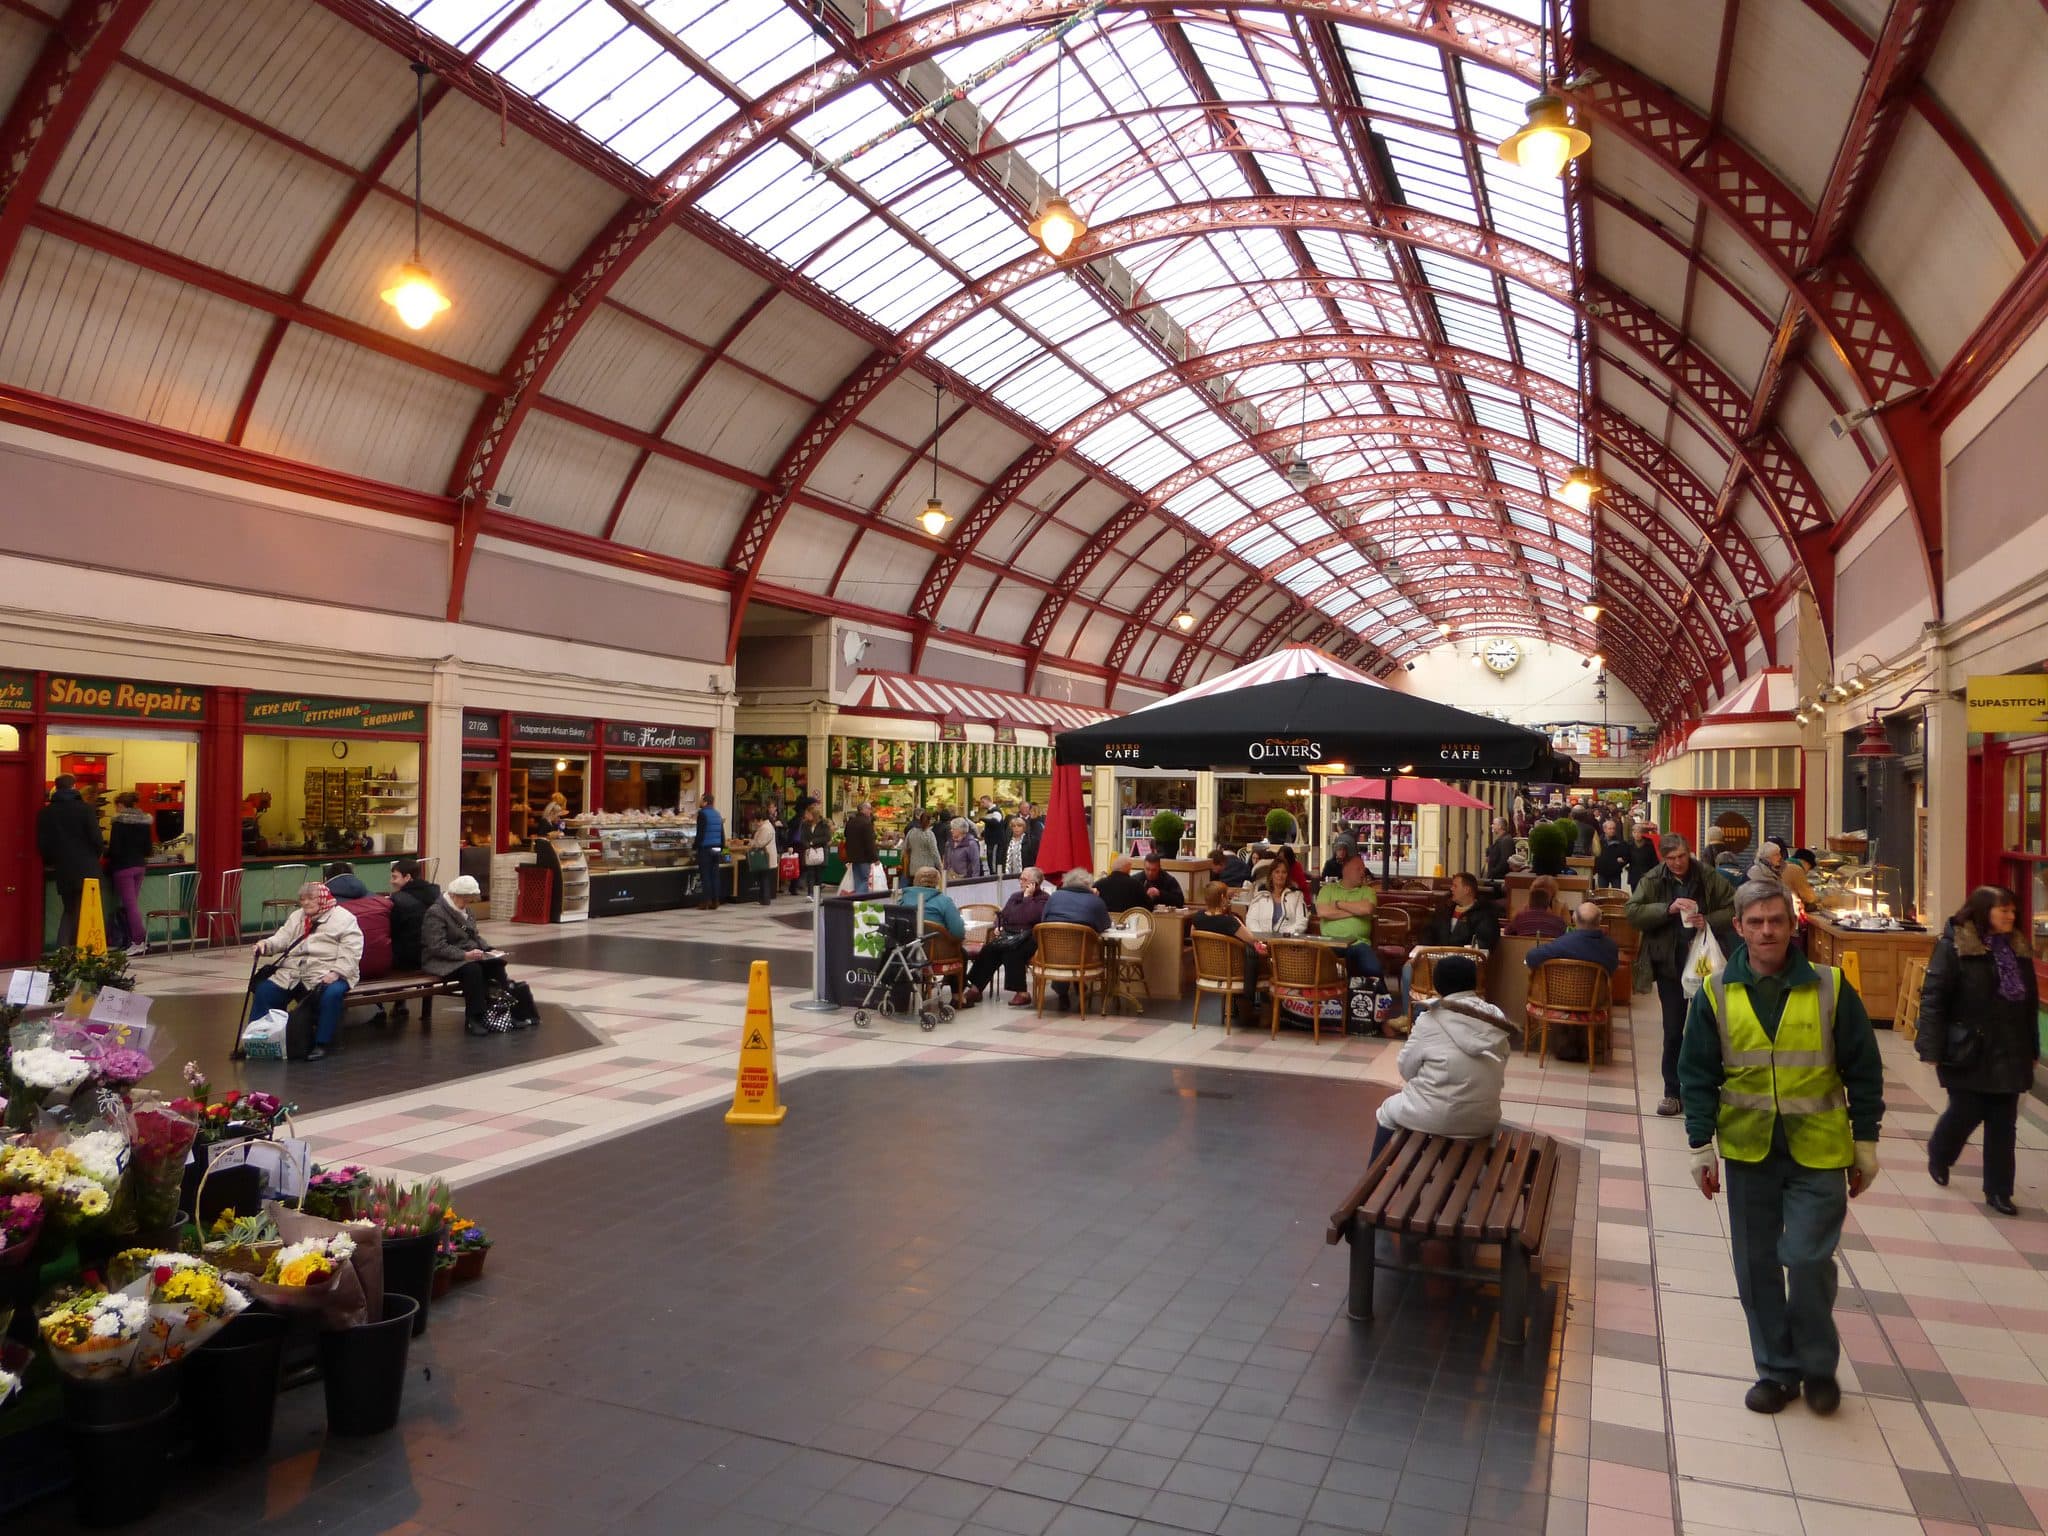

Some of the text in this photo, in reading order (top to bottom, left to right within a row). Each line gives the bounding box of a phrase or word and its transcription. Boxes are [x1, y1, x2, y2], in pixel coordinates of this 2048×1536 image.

[50, 678, 202, 716] Shoe Repairs
[1969, 698, 2046, 707] SUPASTITCH
[253, 701, 302, 716] KEYS CUT
[304, 705, 362, 722] STITCHING
[363, 710, 416, 727] ENGRAVING
[468, 720, 489, 732] 27/28
[519, 723, 586, 738] Independent Artisan Bakery
[623, 727, 696, 748] the French oven
[1105, 750, 1140, 758] CAFE
[1248, 742, 1322, 760] OLIVERS
[1440, 750, 1480, 760] CAFE
